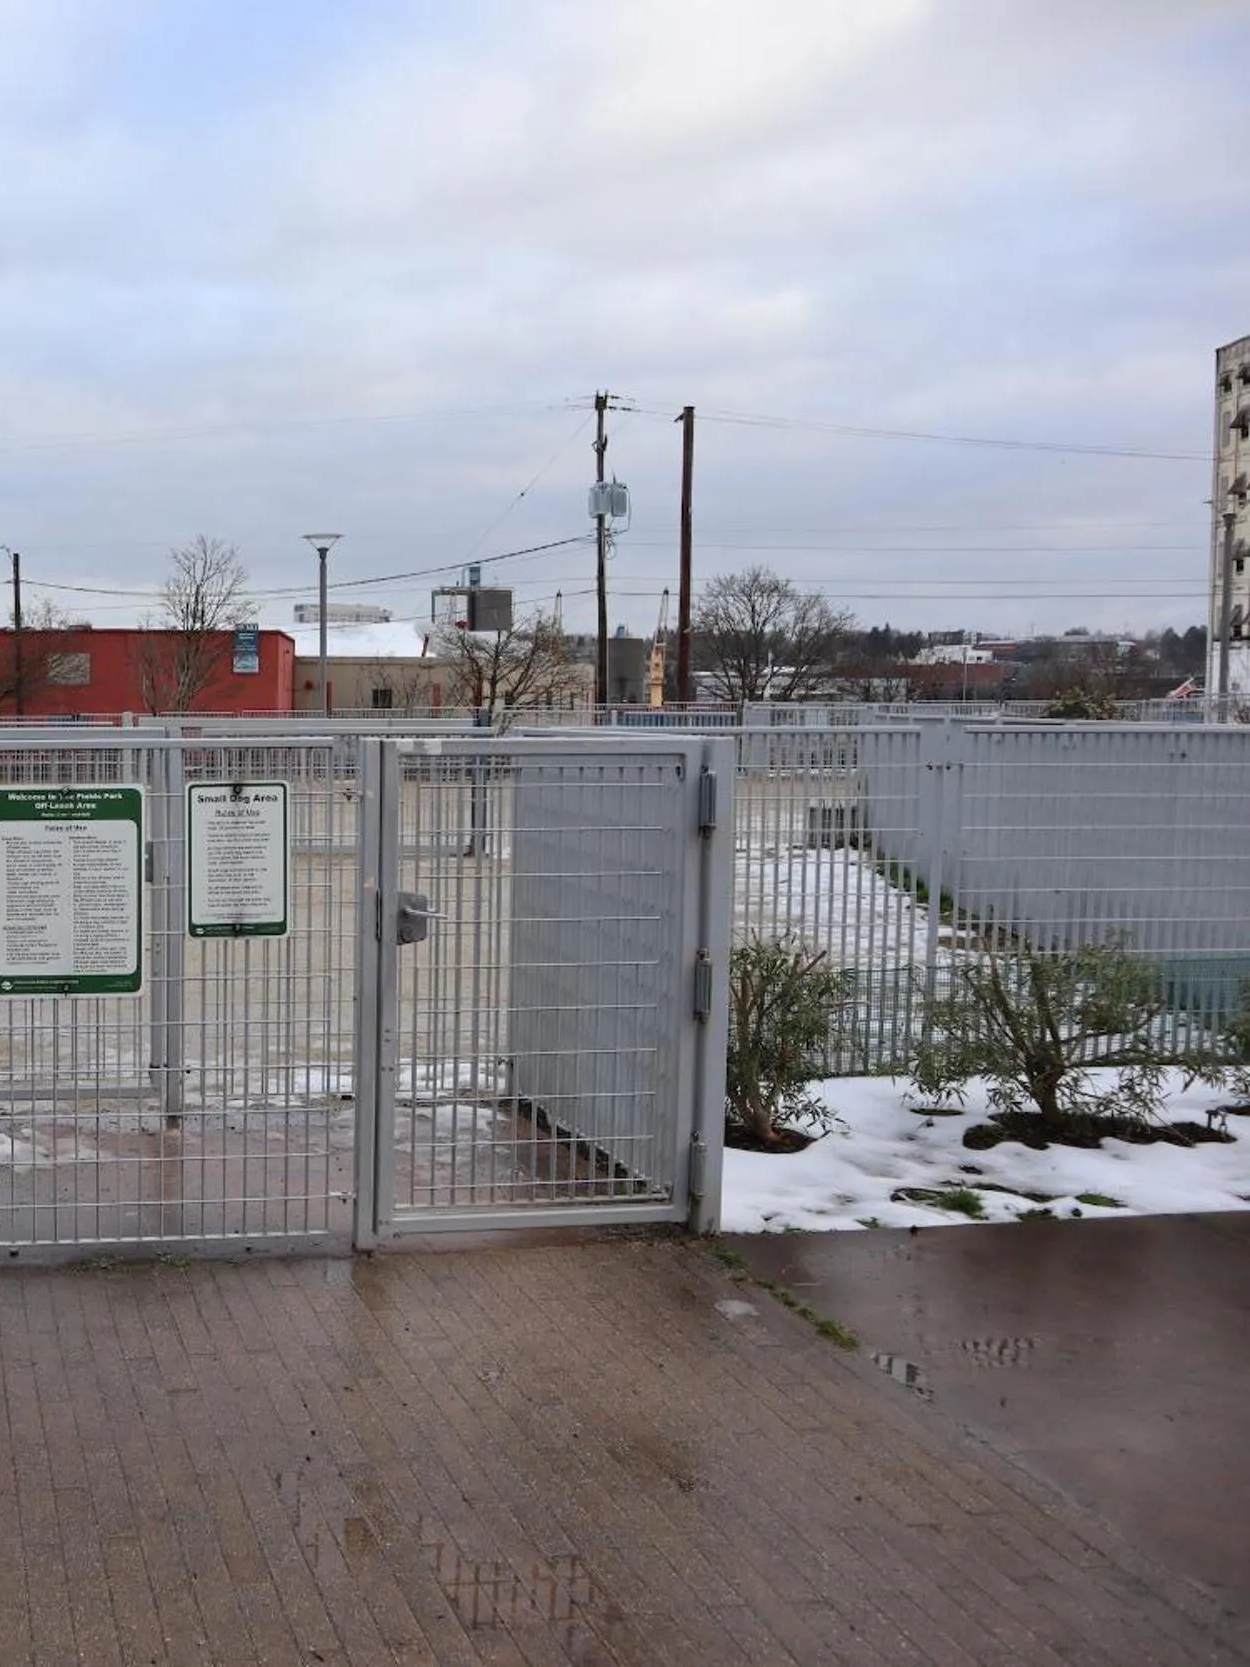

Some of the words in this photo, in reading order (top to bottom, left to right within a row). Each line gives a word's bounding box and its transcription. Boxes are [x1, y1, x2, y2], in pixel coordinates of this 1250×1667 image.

[76, 792, 102, 800] Fields
[197, 794, 226, 803] Small
[229, 794, 250, 804] Dog
[253, 794, 278, 802] Area
